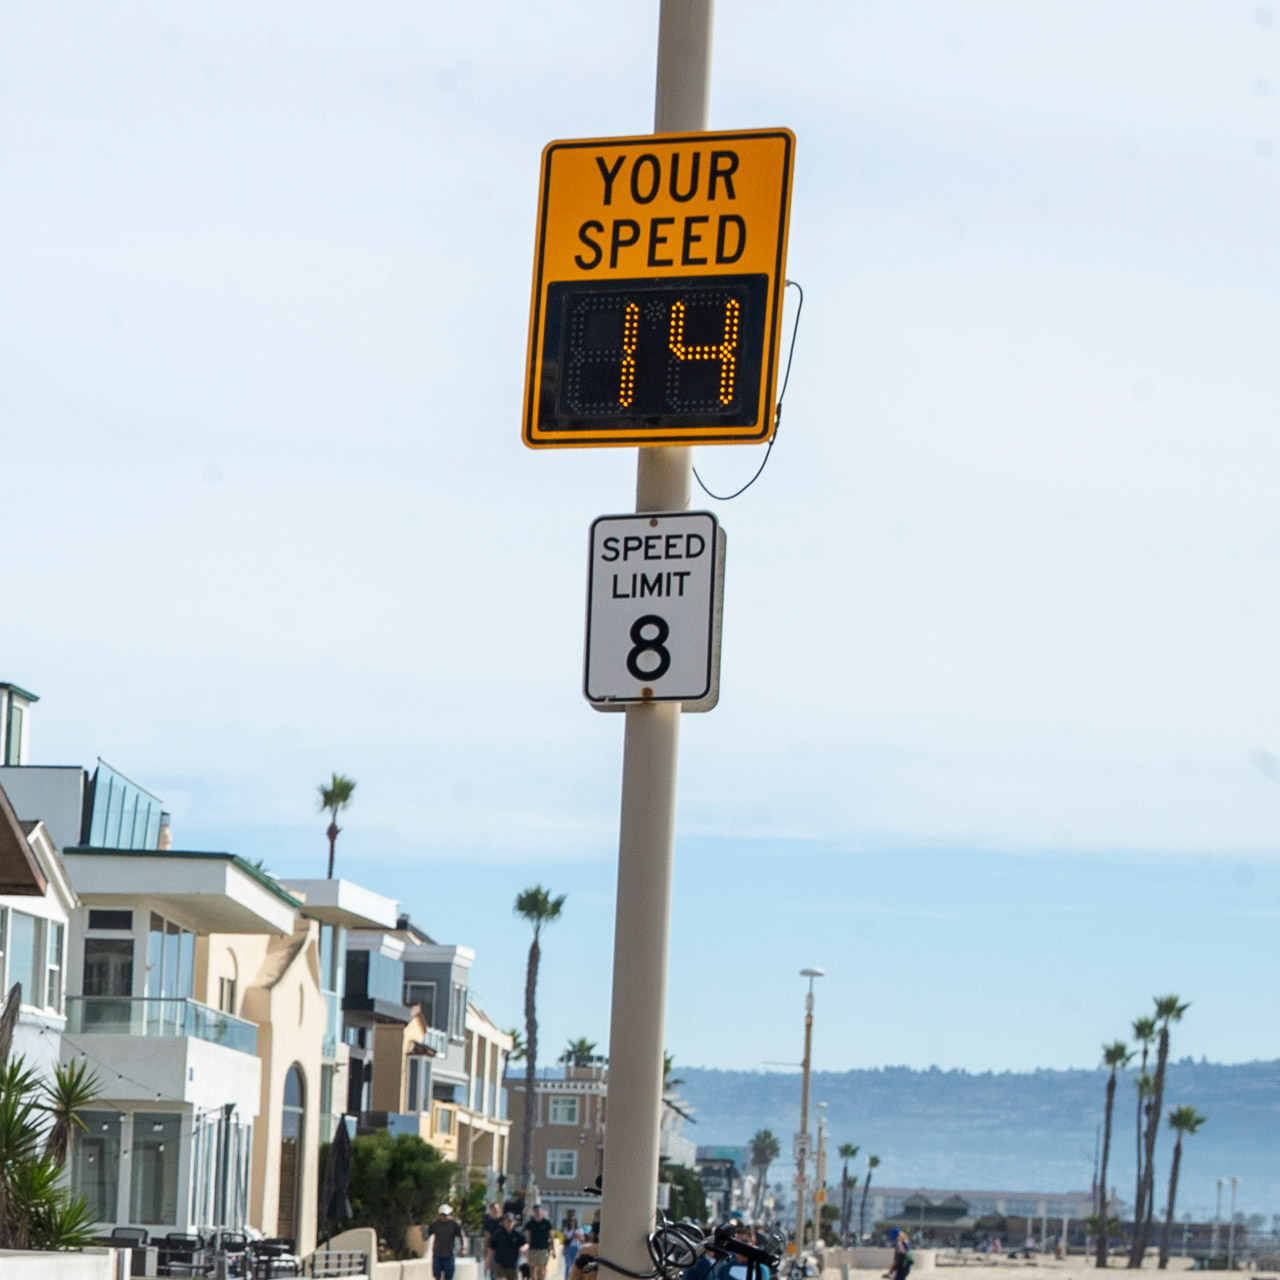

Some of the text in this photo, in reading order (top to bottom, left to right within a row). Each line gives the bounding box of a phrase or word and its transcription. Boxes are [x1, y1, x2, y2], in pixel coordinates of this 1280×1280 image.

[595, 149, 740, 206] YOUR
[573, 214, 748, 270] SPEED
[618, 298, 741, 408] 14
[600, 533, 705, 563] SPEED
[611, 571, 691, 600] LIMIT
[625, 614, 671, 682] 8
